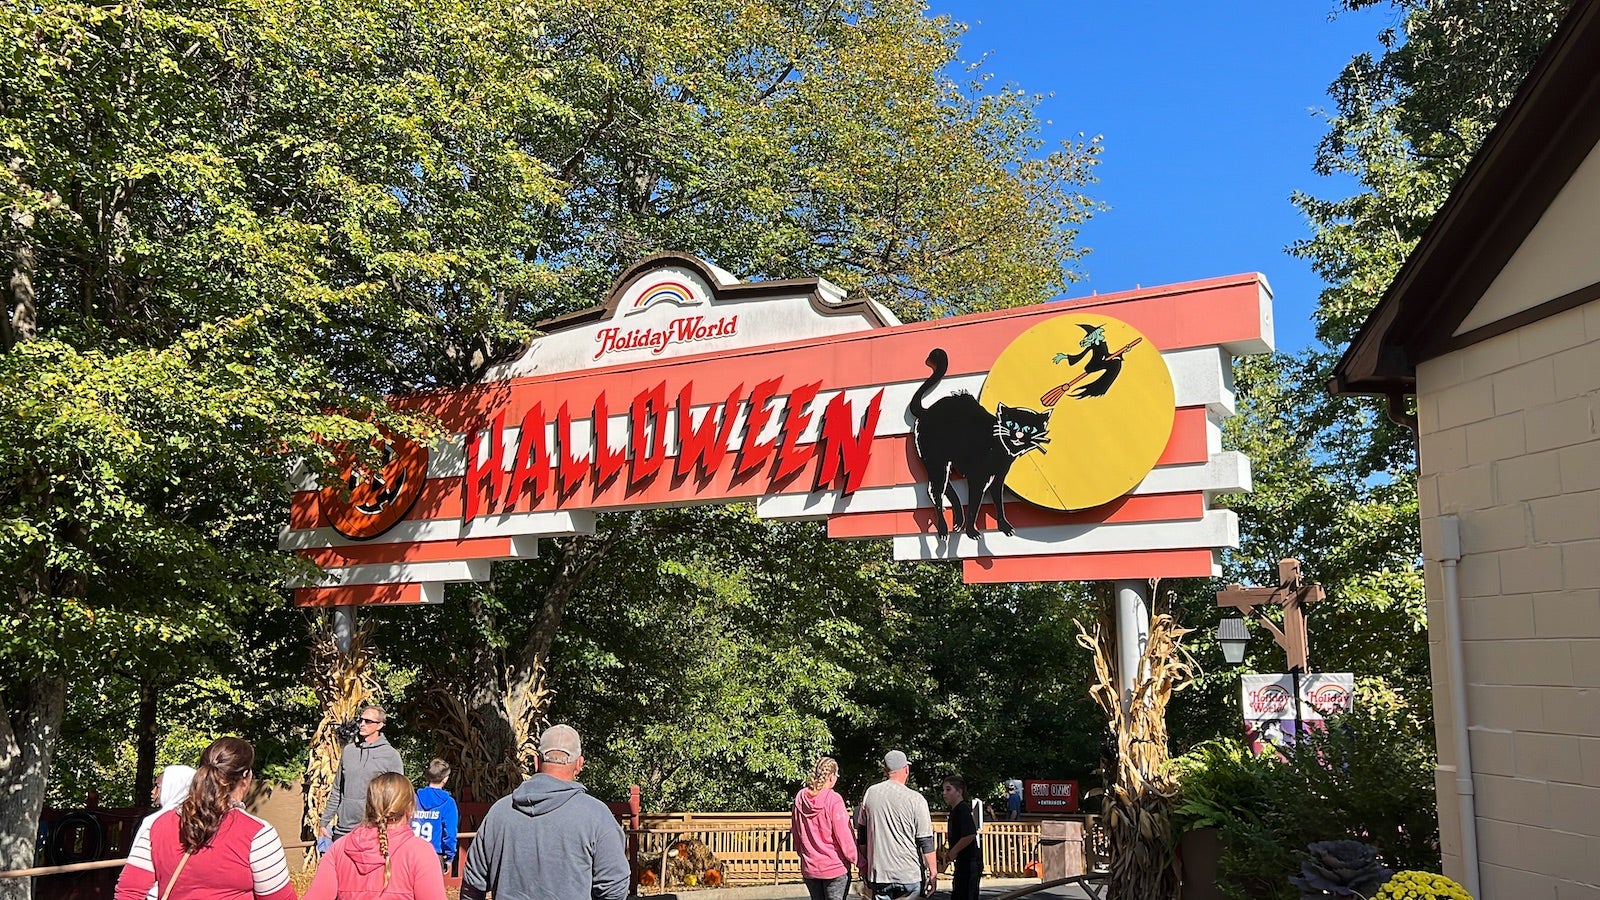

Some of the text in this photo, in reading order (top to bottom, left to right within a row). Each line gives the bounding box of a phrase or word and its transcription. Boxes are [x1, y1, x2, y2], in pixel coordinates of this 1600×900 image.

[593, 315, 738, 360] Holiday World
[464, 375, 885, 523] HALLOWEEN
[1249, 690, 1289, 706] Holiday
[1306, 690, 1350, 706] Holiday
[1031, 783, 1072, 796] EXIT ONLY
